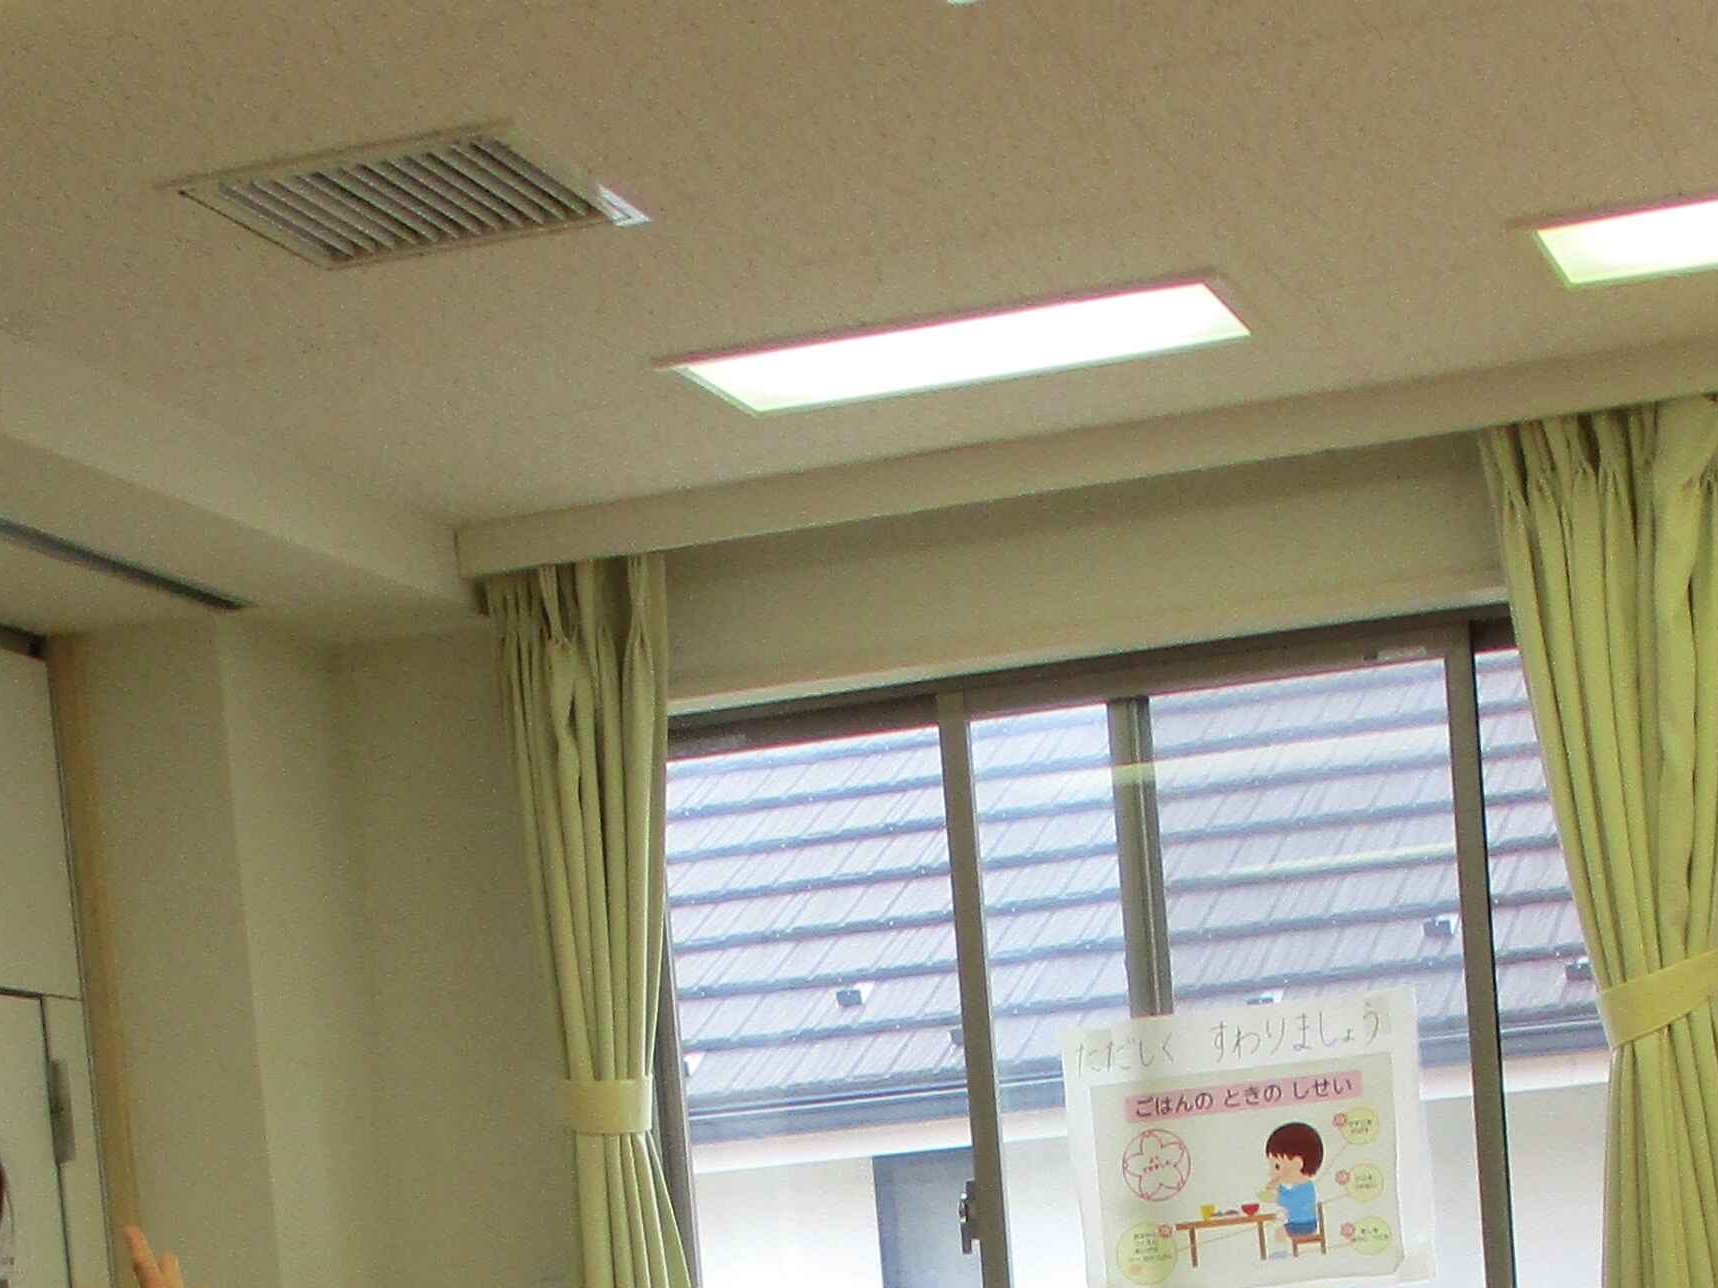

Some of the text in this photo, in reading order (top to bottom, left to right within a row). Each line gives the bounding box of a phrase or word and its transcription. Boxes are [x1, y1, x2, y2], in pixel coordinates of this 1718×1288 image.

[1075, 1003, 1381, 1077] ただしく すわりましょう
[1135, 1077, 1352, 1118] ごはんの ときの しせい
